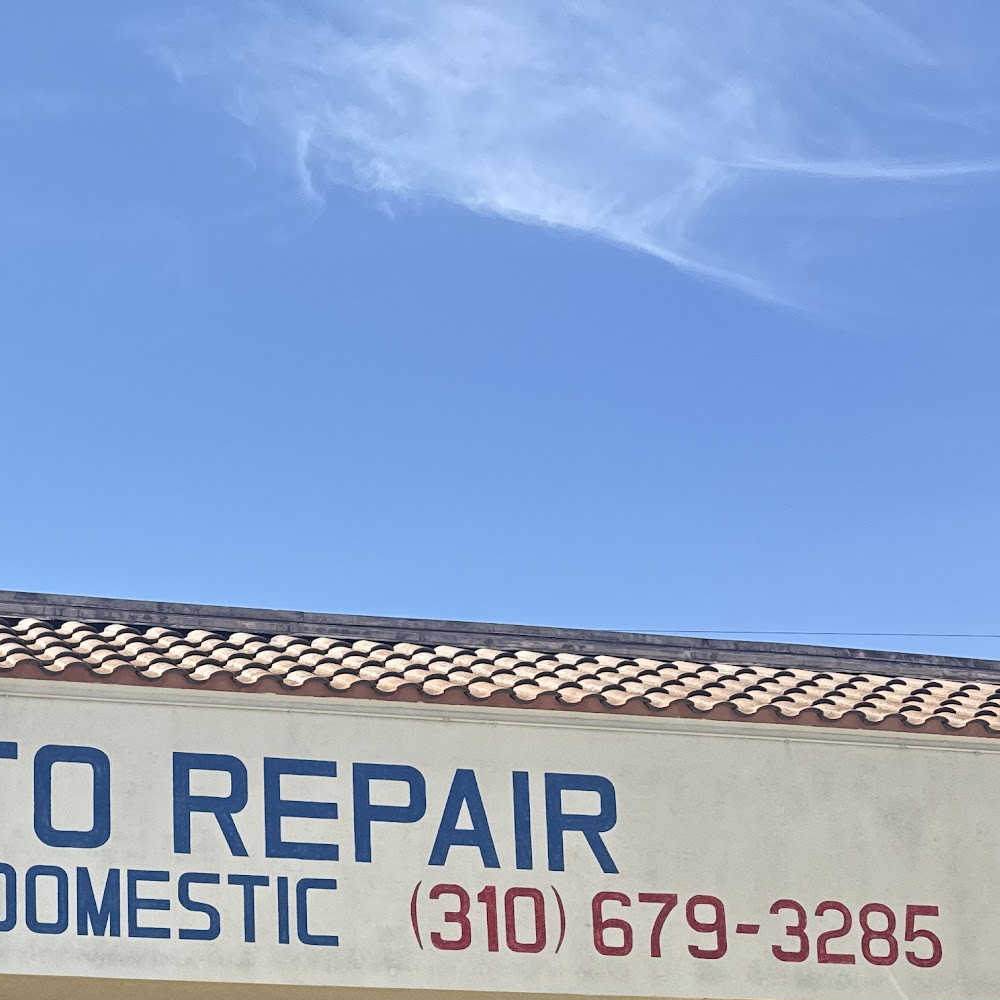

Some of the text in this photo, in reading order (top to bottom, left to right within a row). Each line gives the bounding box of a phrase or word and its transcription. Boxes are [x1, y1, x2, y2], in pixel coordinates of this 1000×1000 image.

[173, 752, 619, 875] REPAIR
[410, 881, 942, 968] (310) 679-3285
